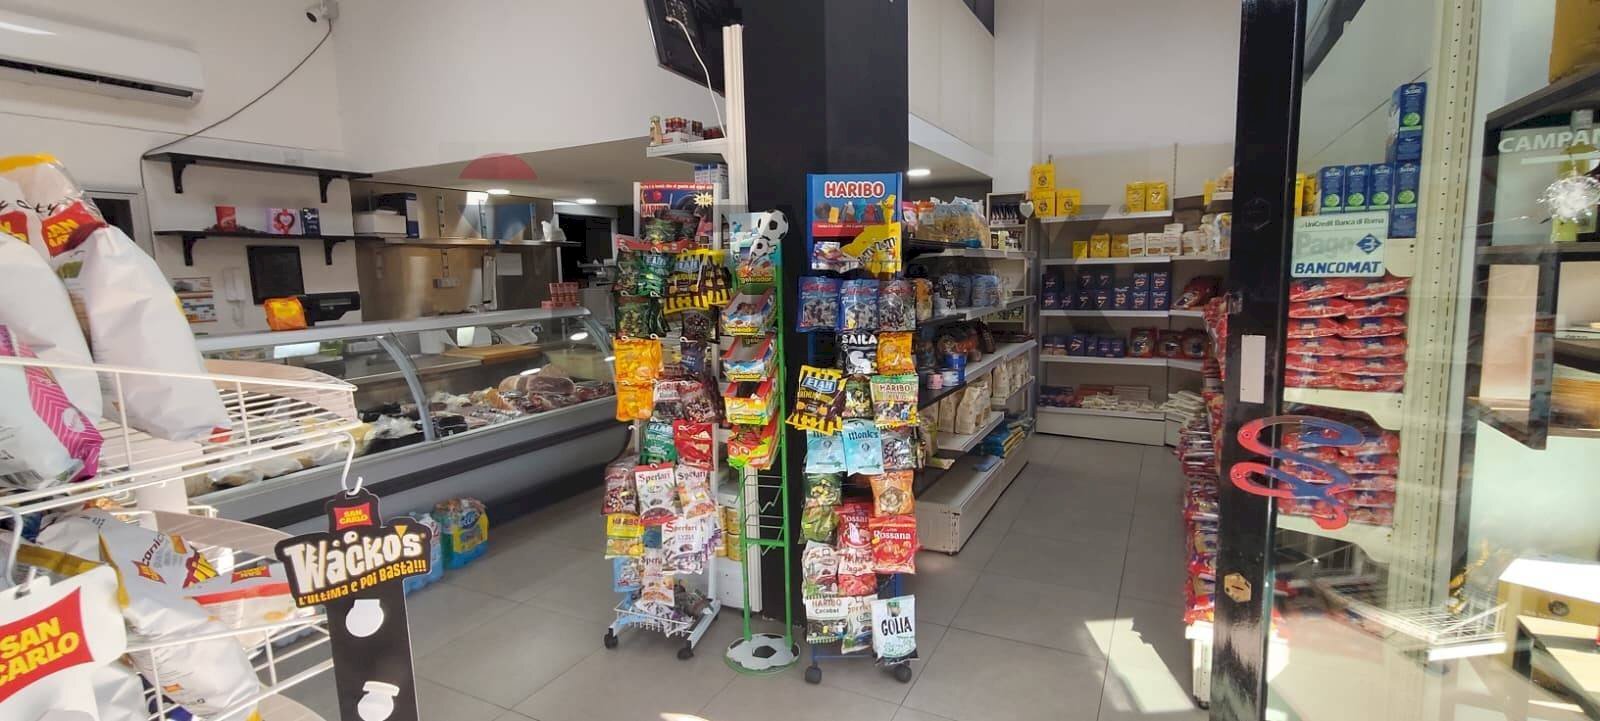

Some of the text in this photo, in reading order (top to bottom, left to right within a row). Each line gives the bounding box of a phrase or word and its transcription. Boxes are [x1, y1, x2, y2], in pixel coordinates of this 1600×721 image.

[825, 181, 885, 198] HARIBO
[1295, 261, 1382, 274] BANCOMAT
[842, 334, 877, 345] SAILA
[880, 384, 911, 392] HARIBO
[639, 472, 671, 483] Sperlari
[874, 530, 911, 540] Rossana
[881, 616, 912, 637] GOLIA
[0, 617, 61, 659] SAN
[0, 631, 80, 687] CARLO
